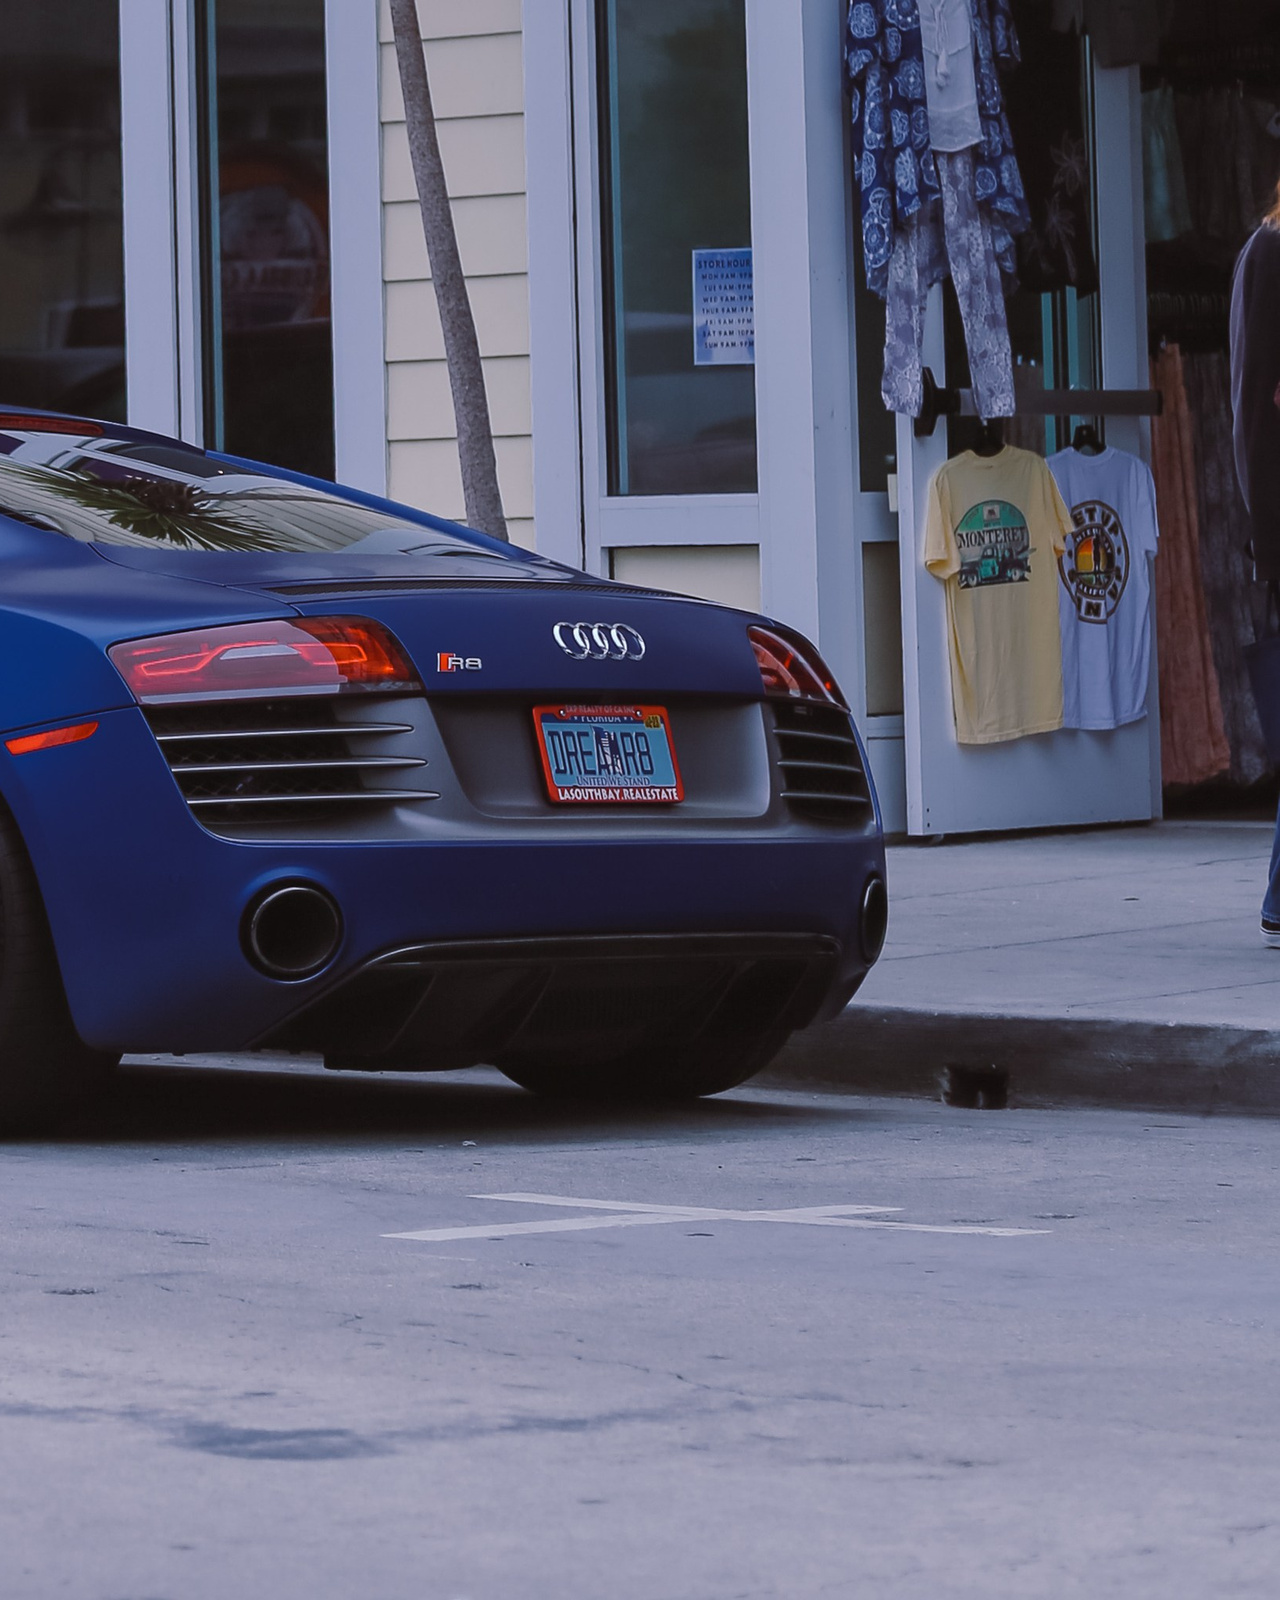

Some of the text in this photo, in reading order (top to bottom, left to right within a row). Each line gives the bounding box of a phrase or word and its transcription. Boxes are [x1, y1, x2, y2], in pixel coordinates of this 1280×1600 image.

[698, 259, 752, 269] STORE HOUR
[448, 657, 483, 670] R8
[579, 705, 603, 714] REALTY
[604, 705, 614, 714] OF
[577, 775, 608, 786] UNITED
[624, 775, 650, 786] STAND
[558, 787, 679, 800] LASOUTHBAY.REALESTATE
